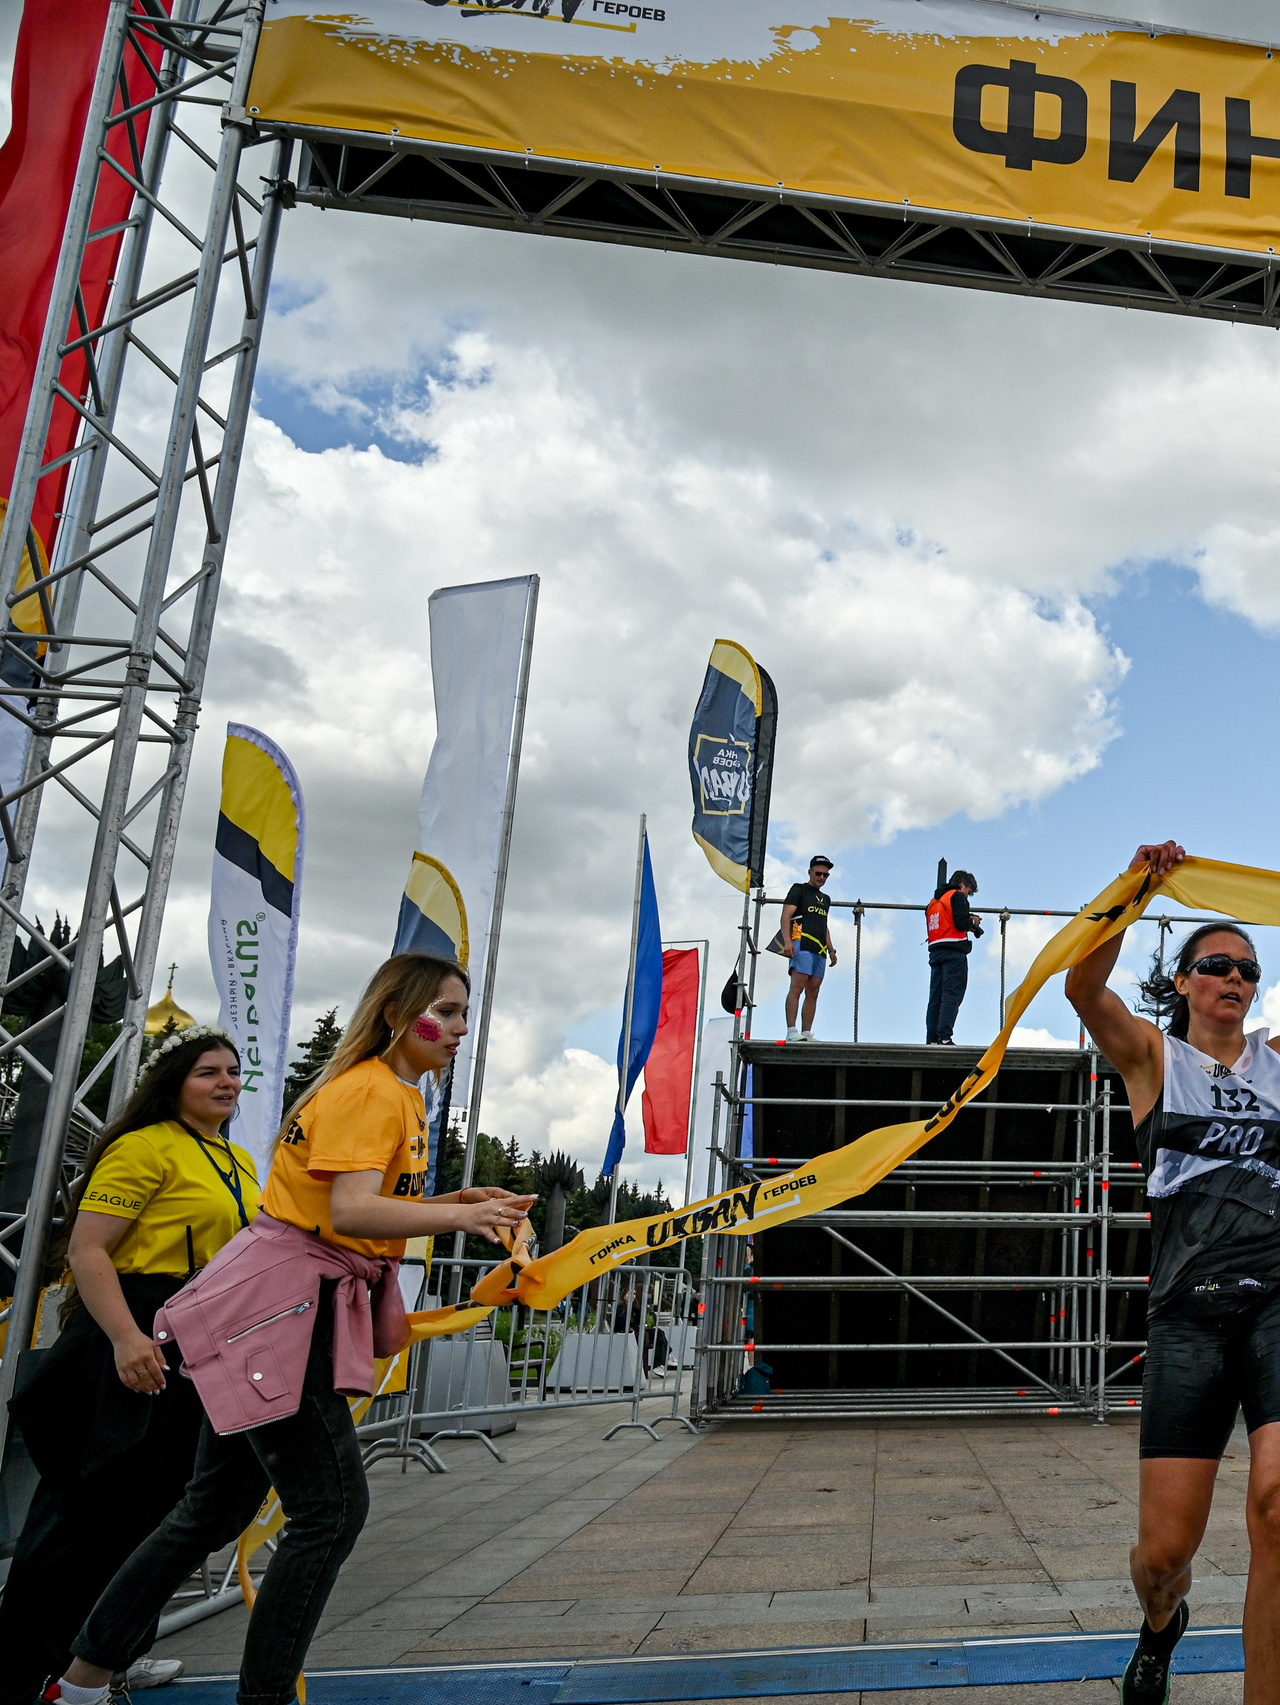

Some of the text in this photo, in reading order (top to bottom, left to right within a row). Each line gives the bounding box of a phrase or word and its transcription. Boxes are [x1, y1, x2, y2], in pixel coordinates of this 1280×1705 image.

[592, 0, 666, 21] ГЕРОЕВ
[1211, 1083, 1260, 1113] 132
[1199, 1121, 1265, 1157] PRO
[588, 1174, 818, 1266] ГОНКА URBAN ГЕРОЕВ
